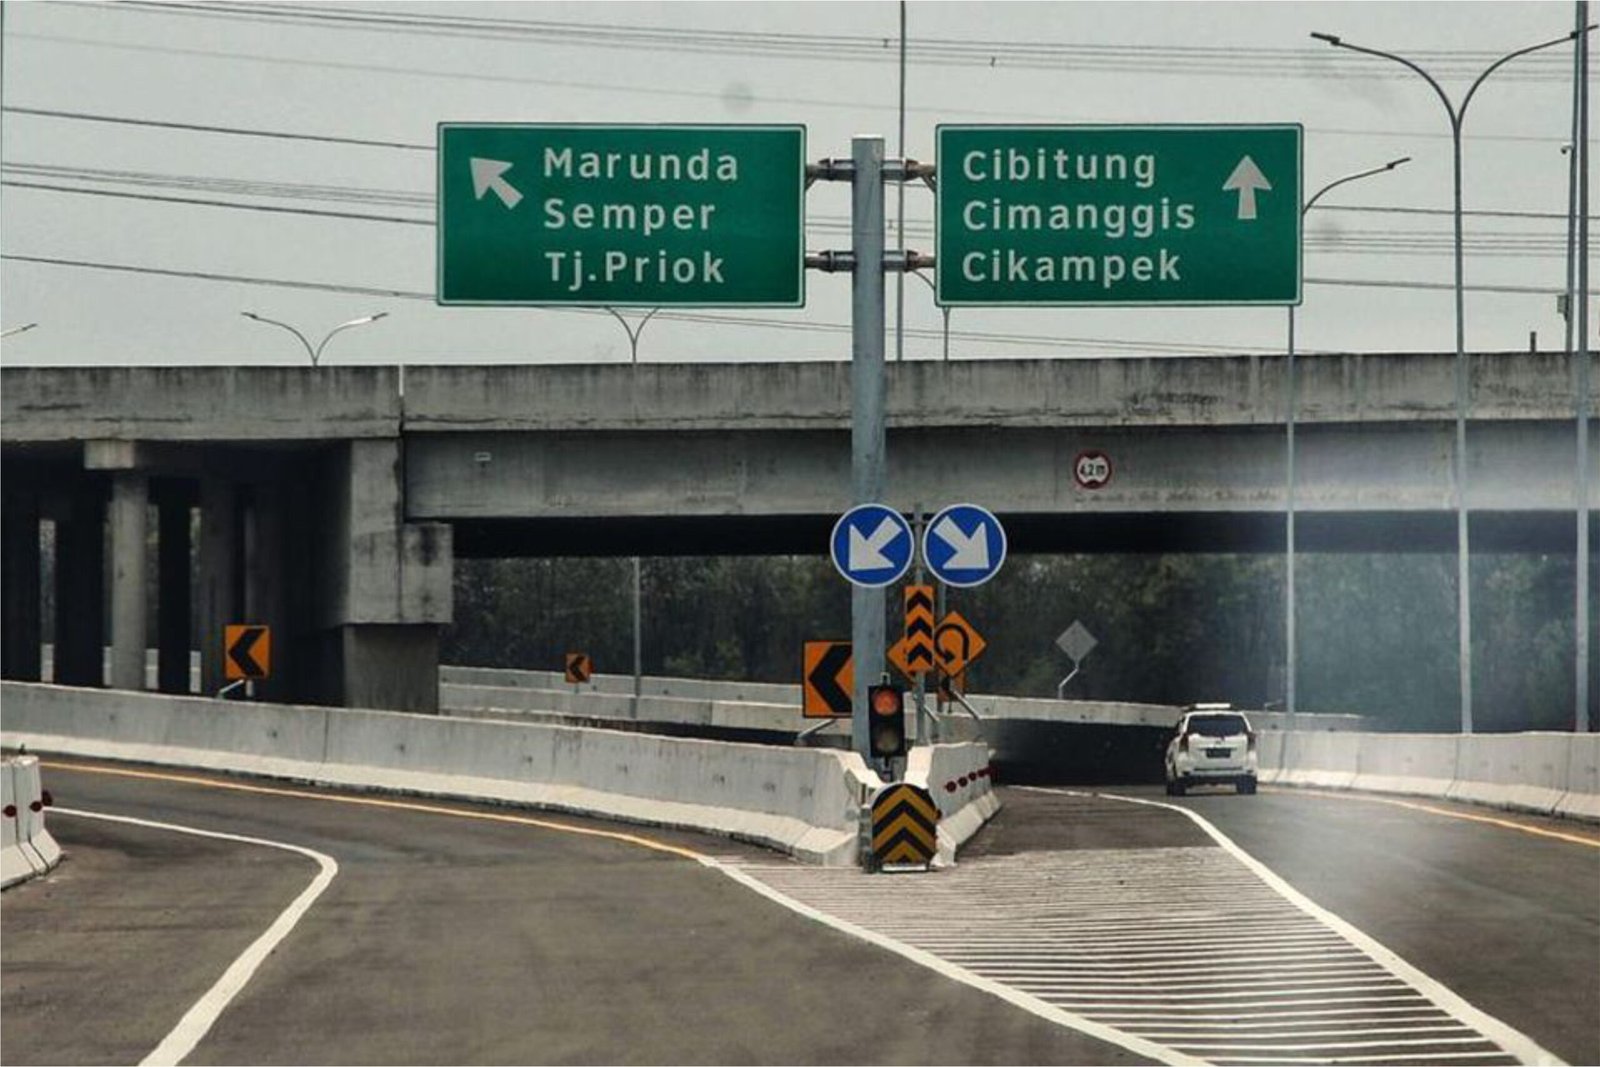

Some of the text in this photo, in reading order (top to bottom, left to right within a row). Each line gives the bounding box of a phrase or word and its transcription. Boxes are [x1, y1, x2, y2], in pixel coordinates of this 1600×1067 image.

[544, 147, 739, 181] Marunda
[963, 148, 1156, 189] Cibitung
[543, 197, 716, 236] Semper
[963, 197, 1196, 239] Cimanggis
[545, 250, 726, 291] Tj.Priok
[962, 249, 1182, 288] Cikampek
